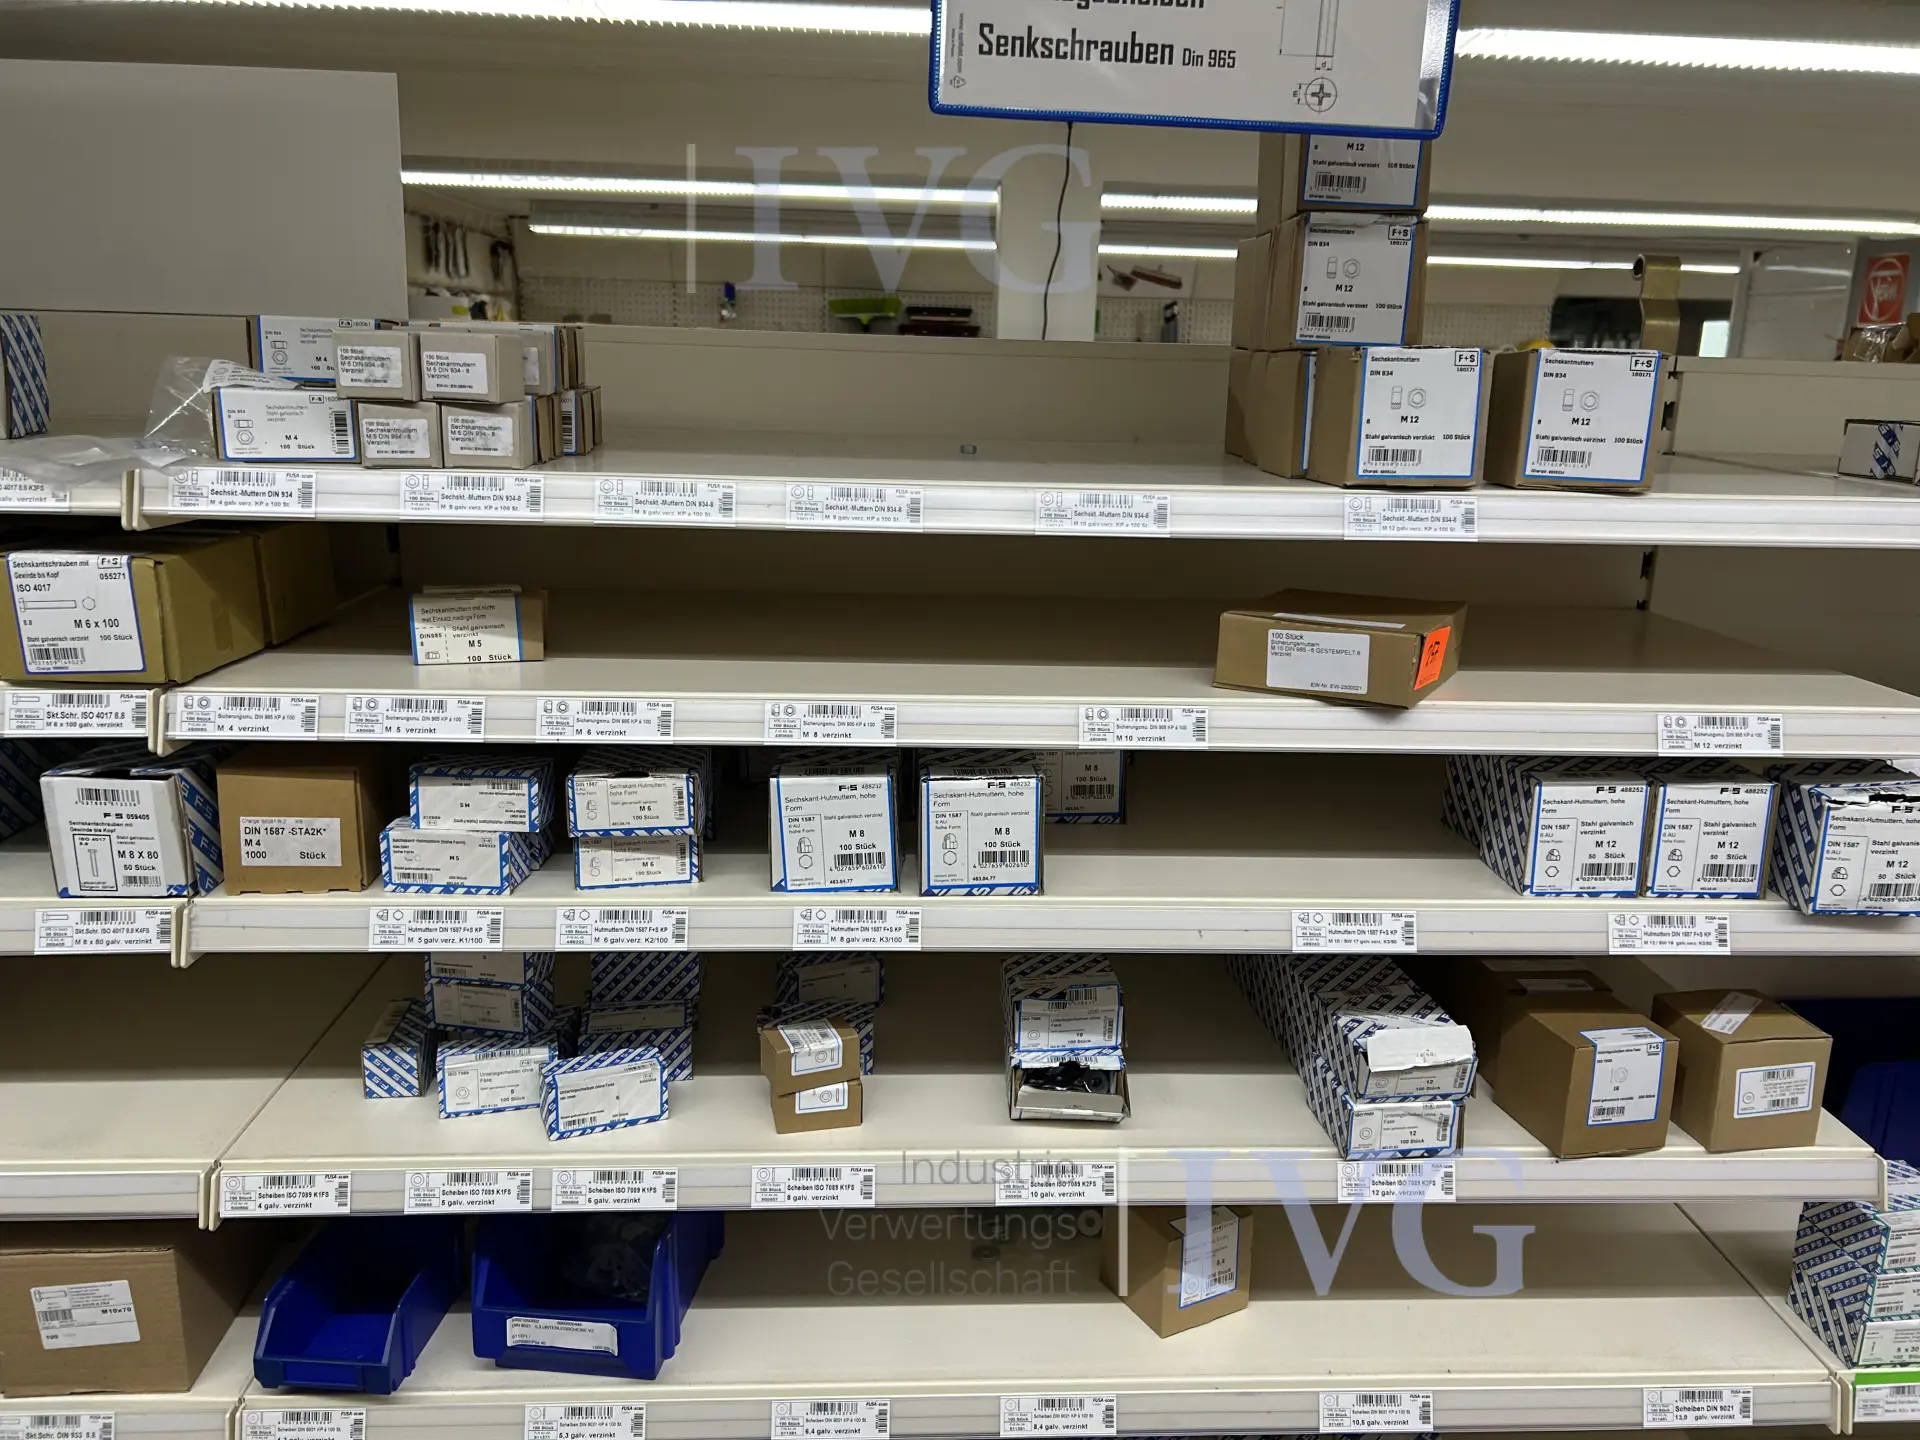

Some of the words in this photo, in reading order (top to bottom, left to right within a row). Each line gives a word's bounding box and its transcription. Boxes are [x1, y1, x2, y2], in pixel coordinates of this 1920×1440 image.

[978, 23, 1174, 66] Senkschrauben
[1182, 48, 1203, 66] Din
[1208, 50, 1236, 68] 965
[1545, 358, 1594, 366] Sechskantmuttern
[1634, 360, 1652, 368] F+S
[1581, 418, 1590, 426] 12
[17, 584, 30, 592] ISO
[33, 584, 51, 592] 4017
[74, 620, 82, 628] M
[86, 620, 91, 628] 6
[102, 619, 119, 628] 100
[785, 794, 858, 803] Sechskant-Hutmuttern,
[933, 792, 1006, 800] Sechskant-Hutmuttern,
[1599, 820, 1634, 828] galvanisch
[244, 827, 261, 835] DIN
[118, 851, 126, 859] M
[129, 851, 135, 859] 8
[147, 851, 158, 859] 80
[1898, 860, 1908, 868] 12
[1895, 872, 1916, 880] Stück
